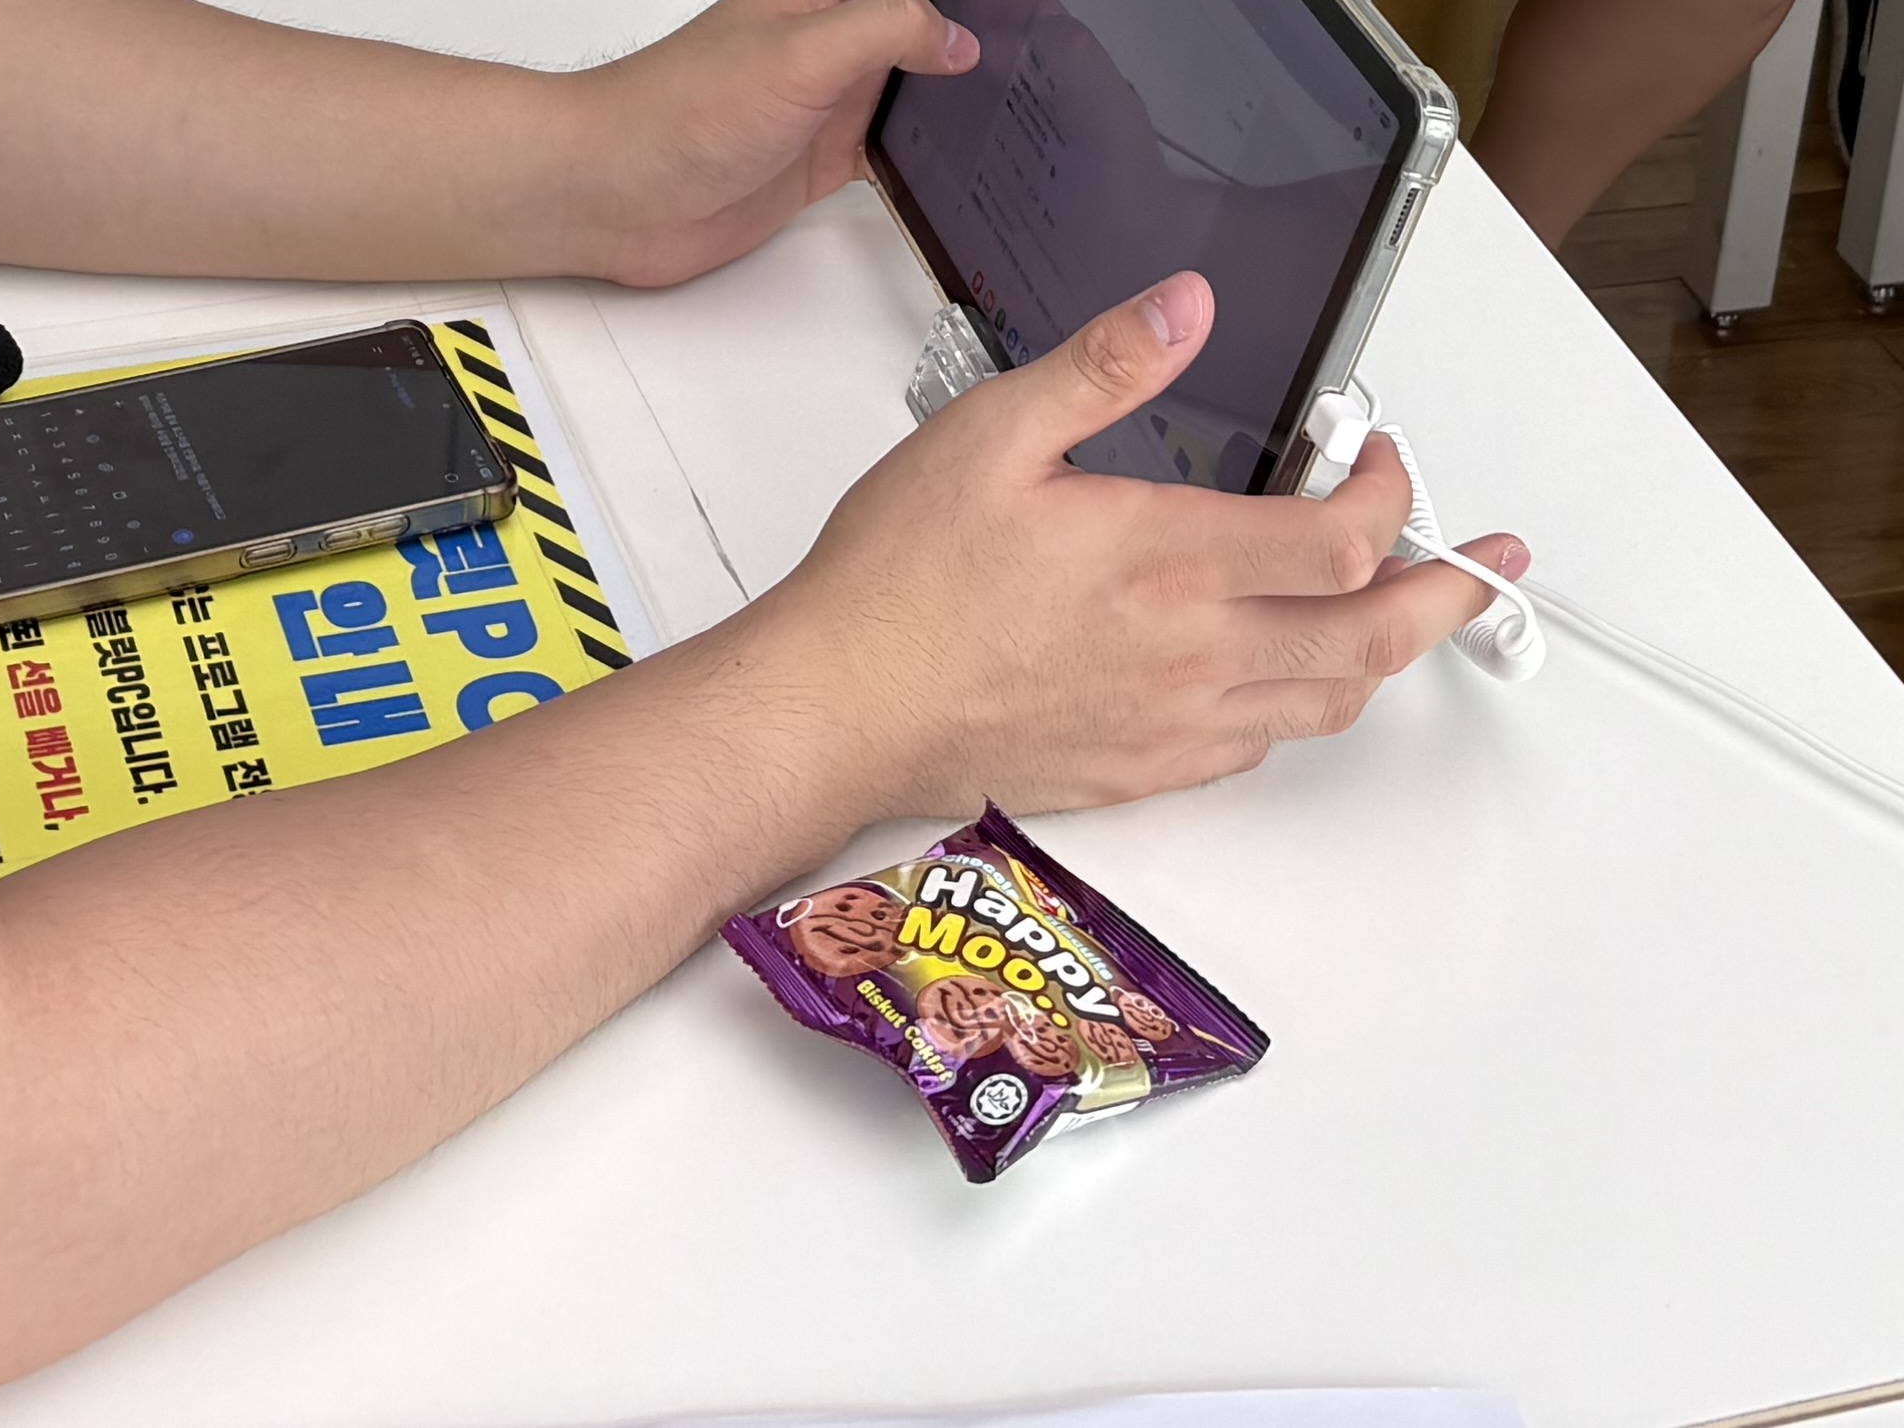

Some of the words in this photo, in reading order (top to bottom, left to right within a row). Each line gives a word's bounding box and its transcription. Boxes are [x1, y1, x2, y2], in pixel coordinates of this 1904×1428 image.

[6, 659, 63, 720] 선을
[82, 598, 179, 806] 블릿PC입니다.
[182, 631, 261, 752] 프로그램
[223, 757, 273, 800] 전
[271, 579, 432, 748] 안내
[24, 725, 90, 832] 빼거나,
[920, 866, 1121, 1018] Happy
[856, 979, 908, 1030] Biskut
[904, 1025, 955, 1082] Coklat
